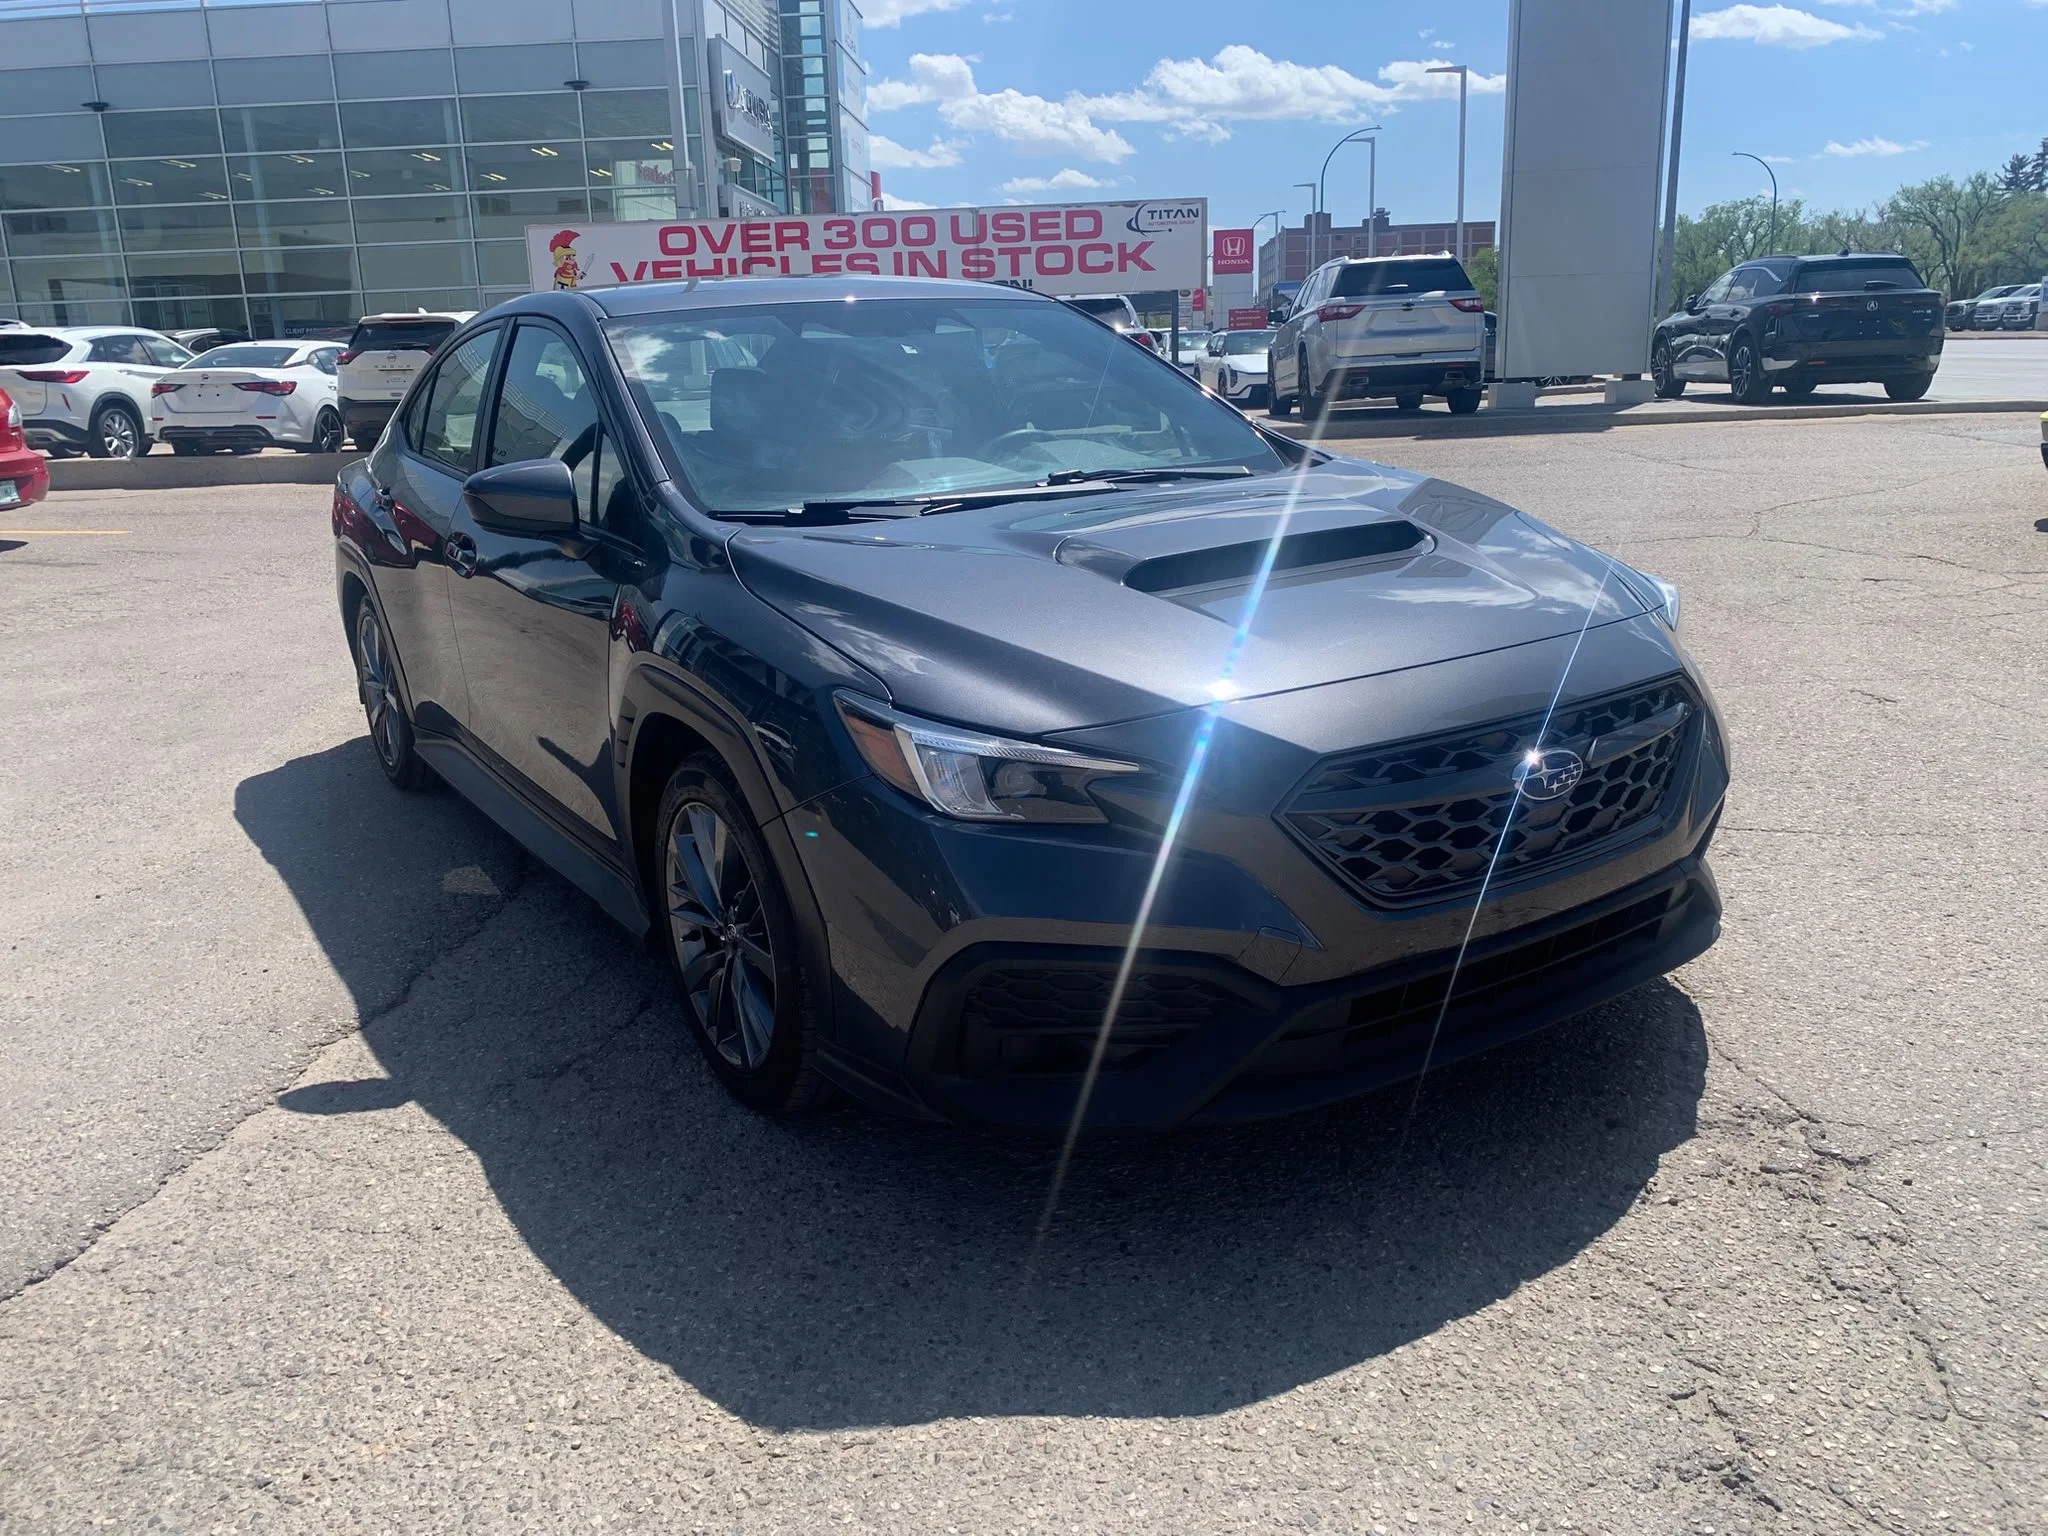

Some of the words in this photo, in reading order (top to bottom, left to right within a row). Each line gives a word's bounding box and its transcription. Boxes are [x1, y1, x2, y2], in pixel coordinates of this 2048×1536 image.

[658, 221, 810, 256] OVER
[823, 216, 936, 250] 300
[950, 209, 1103, 246] USED
[1147, 207, 1199, 220] TITAN
[893, 249, 948, 279] IN
[961, 240, 1156, 279] STOCK
